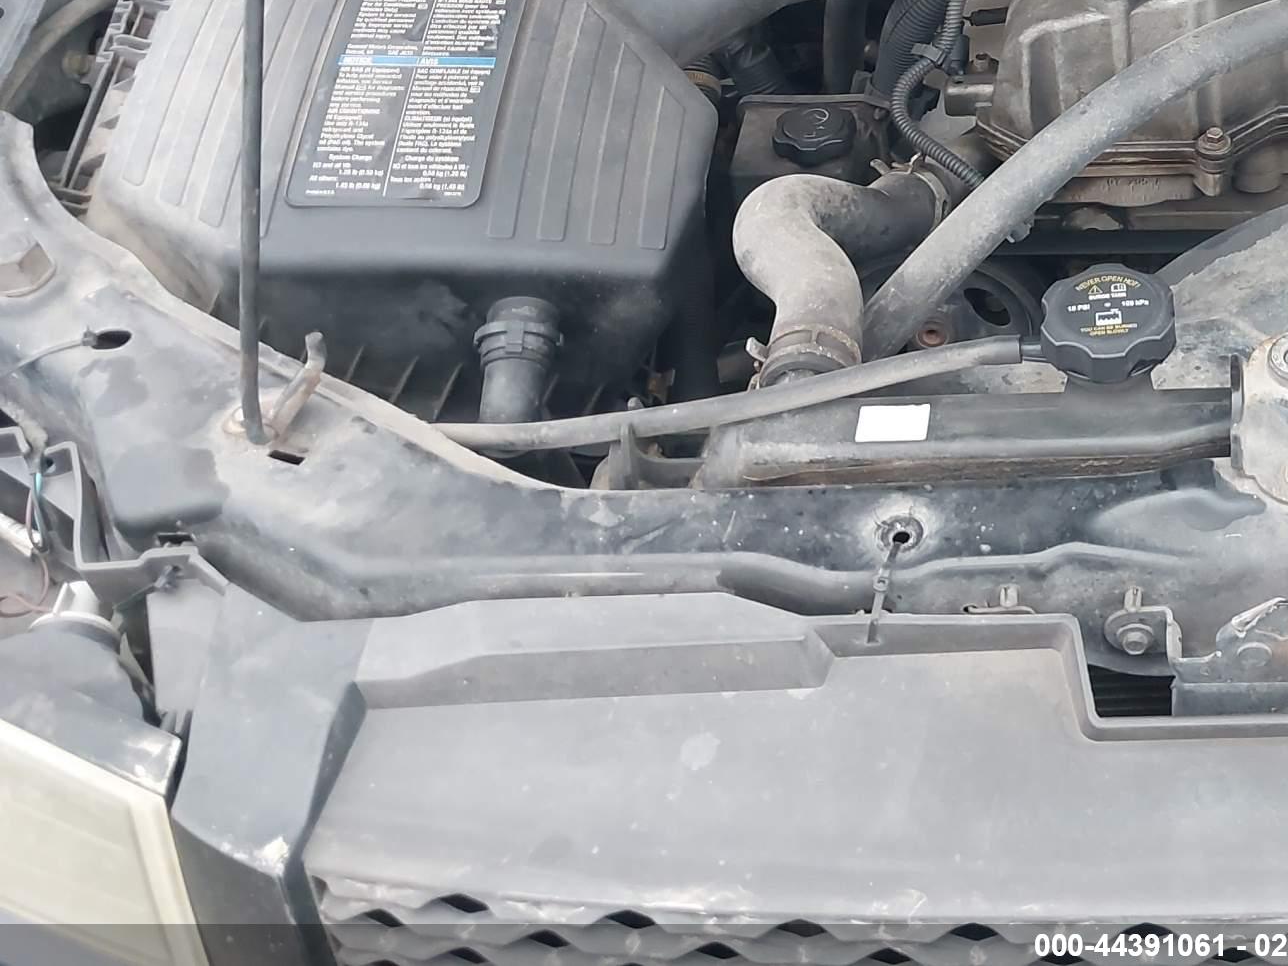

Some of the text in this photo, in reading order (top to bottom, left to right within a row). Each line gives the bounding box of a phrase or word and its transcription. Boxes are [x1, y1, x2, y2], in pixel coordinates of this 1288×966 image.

[1075, 275, 1141, 291] NEVER OPEN HOT!
[1077, 303, 1091, 311] PSI
